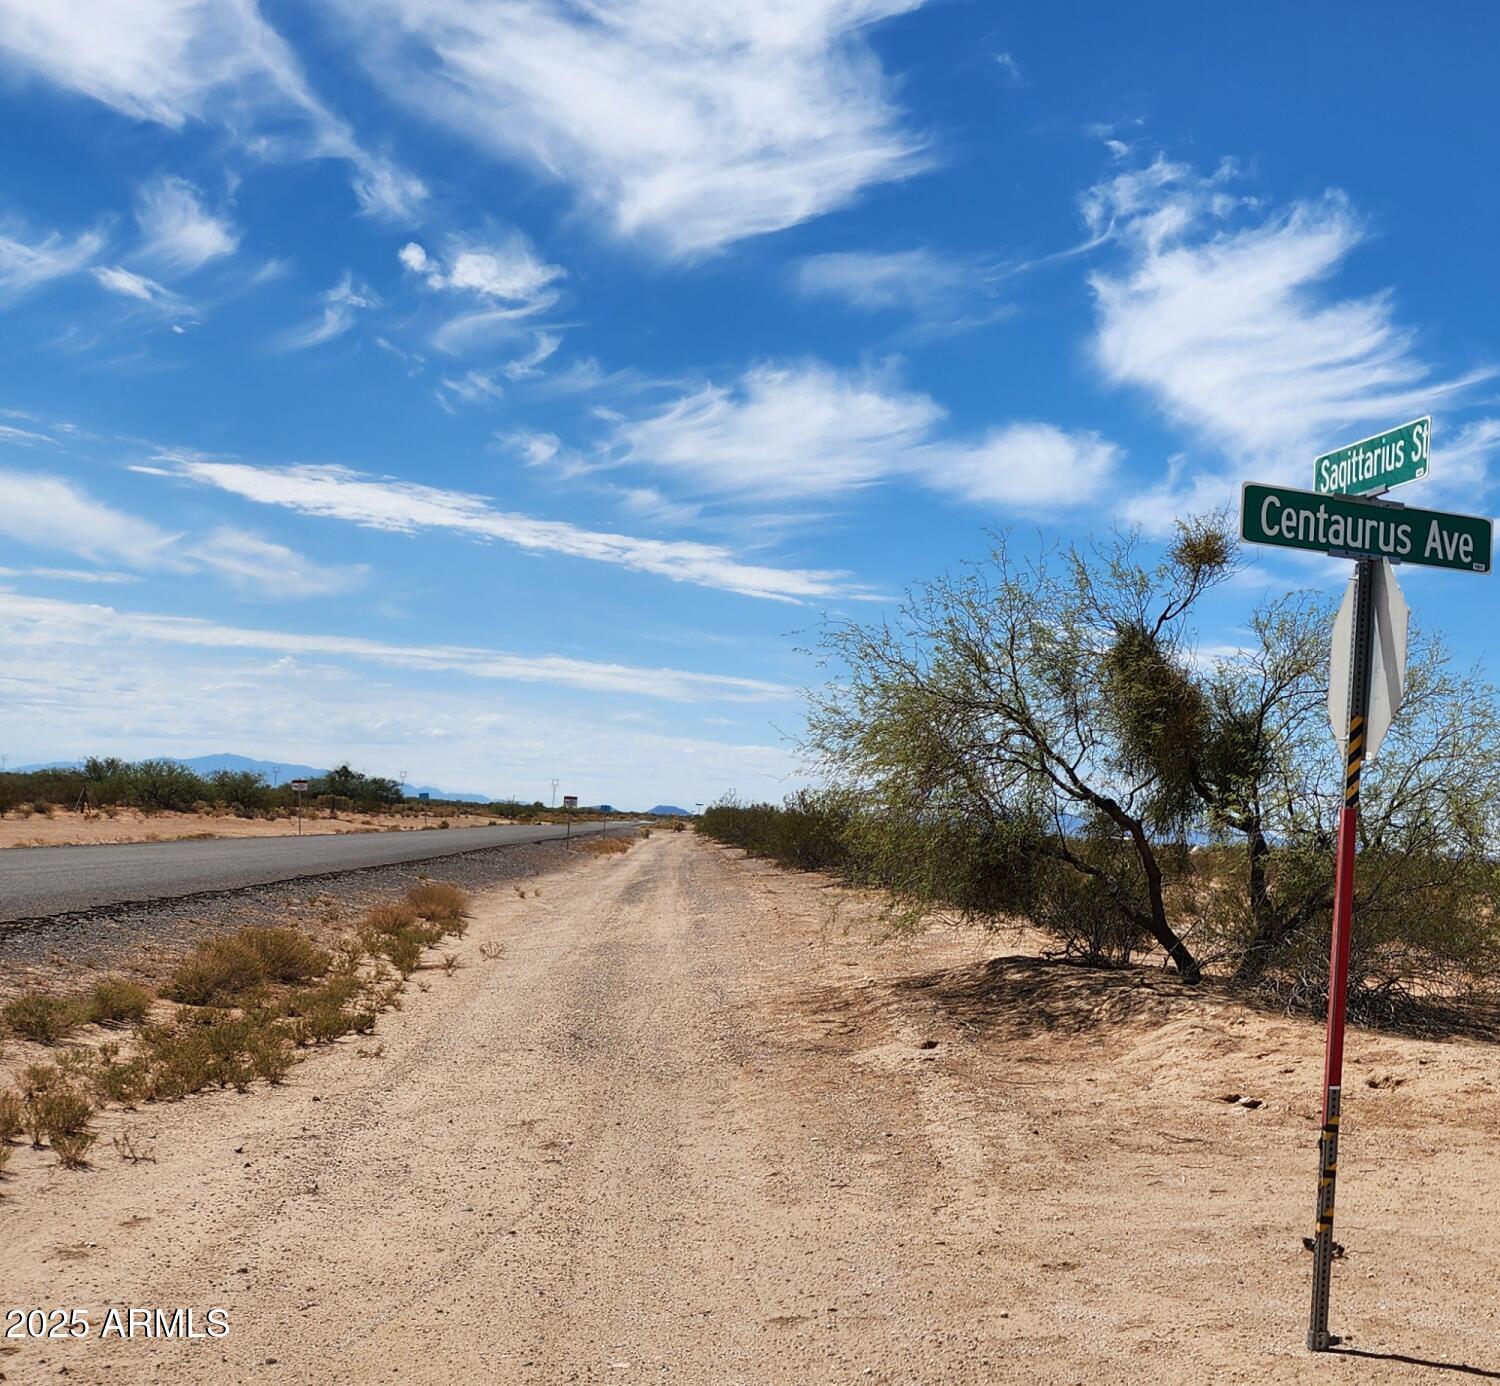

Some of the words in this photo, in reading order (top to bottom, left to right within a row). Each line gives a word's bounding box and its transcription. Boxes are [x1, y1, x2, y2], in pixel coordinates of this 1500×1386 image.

[1320, 438, 1405, 494] Sagittarius
[1411, 423, 1429, 462] St
[1260, 495, 1412, 554] Centaurus
[1424, 520, 1474, 563] Ave
